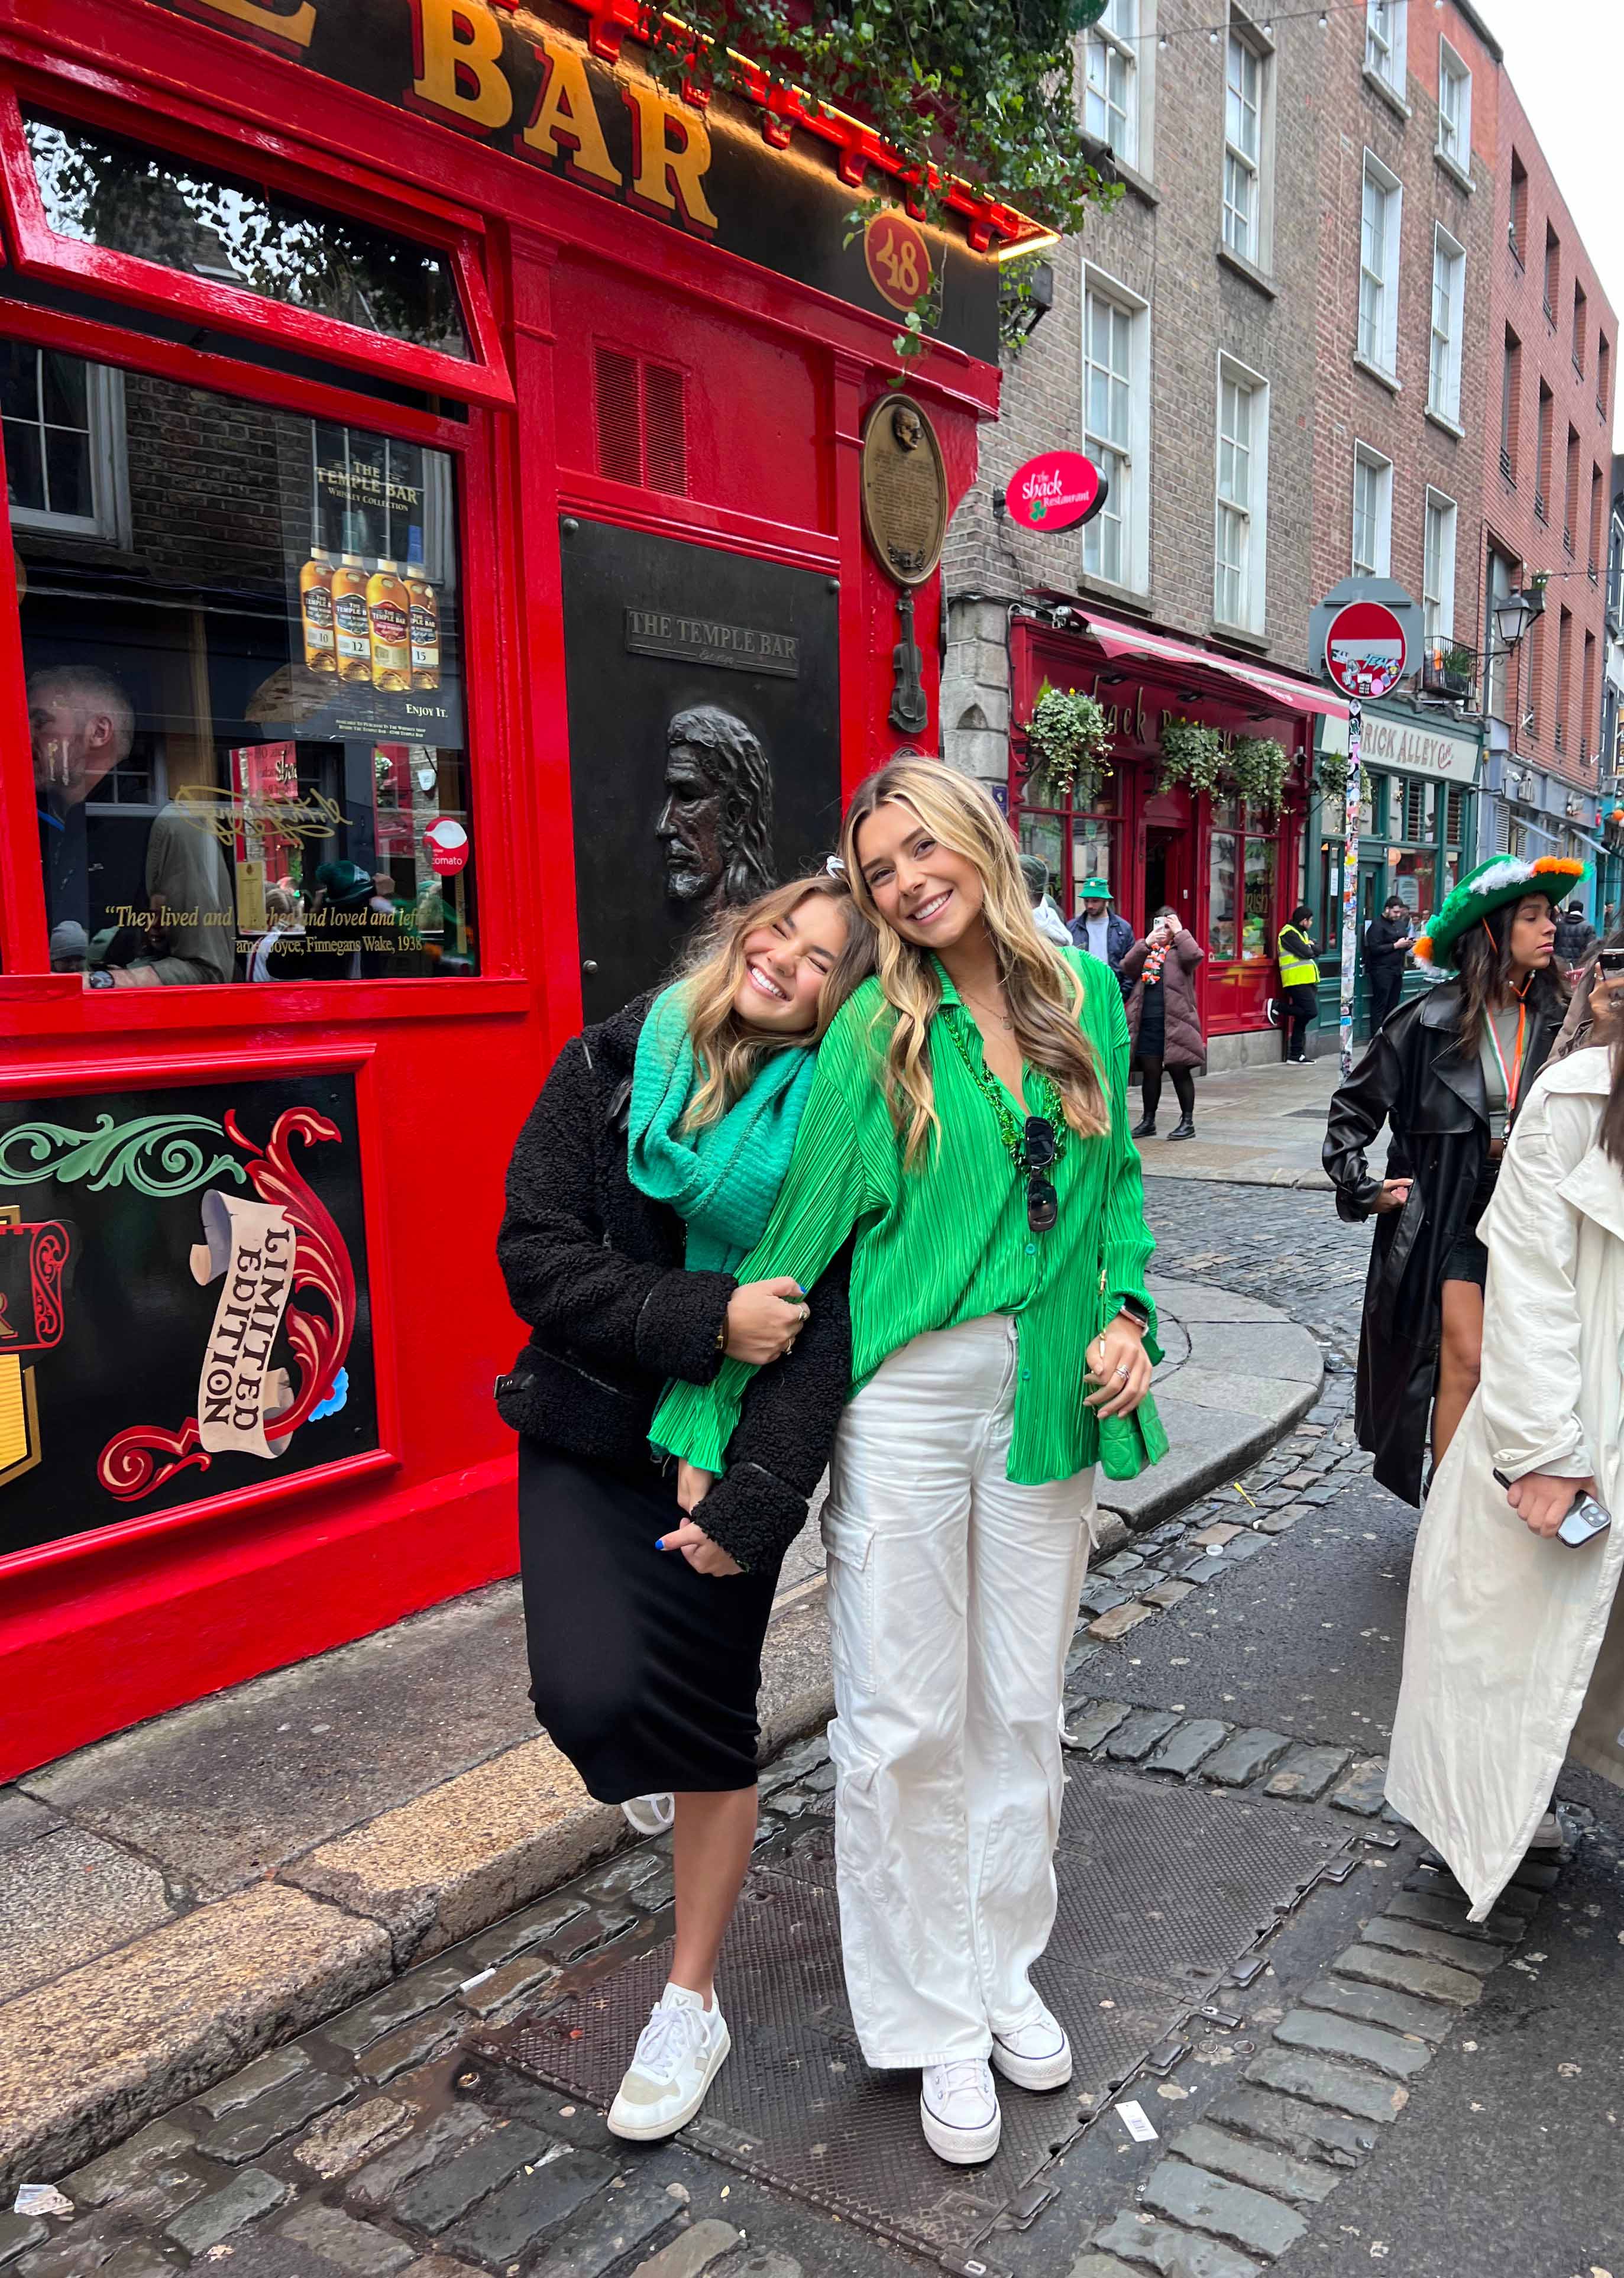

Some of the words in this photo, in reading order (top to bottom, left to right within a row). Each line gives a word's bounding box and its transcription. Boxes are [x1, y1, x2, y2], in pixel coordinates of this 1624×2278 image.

[408, 0, 718, 233] BAR
[876, 228, 920, 295] 48
[313, 467, 381, 494] TEMPLE
[386, 483, 419, 505] BAR
[353, 461, 380, 478] THE
[352, 641, 364, 652] 12
[629, 611, 672, 638] THE
[677, 620, 755, 653] TEMPLE
[758, 634, 798, 659] BAR
[416, 651, 426, 661] 15
[1396, 730, 1438, 767] ALLEY
[160, 905, 199, 927] lived
[203, 907, 232, 927] and
[301, 908, 327, 927] and
[330, 907, 367, 927] loved
[370, 908, 395, 926] and
[306, 936, 361, 956] Finnegans
[362, 936, 396, 954] Wake,
[205, 1244, 262, 1425] EDITION
[234, 1227, 290, 1431] LIMITED
